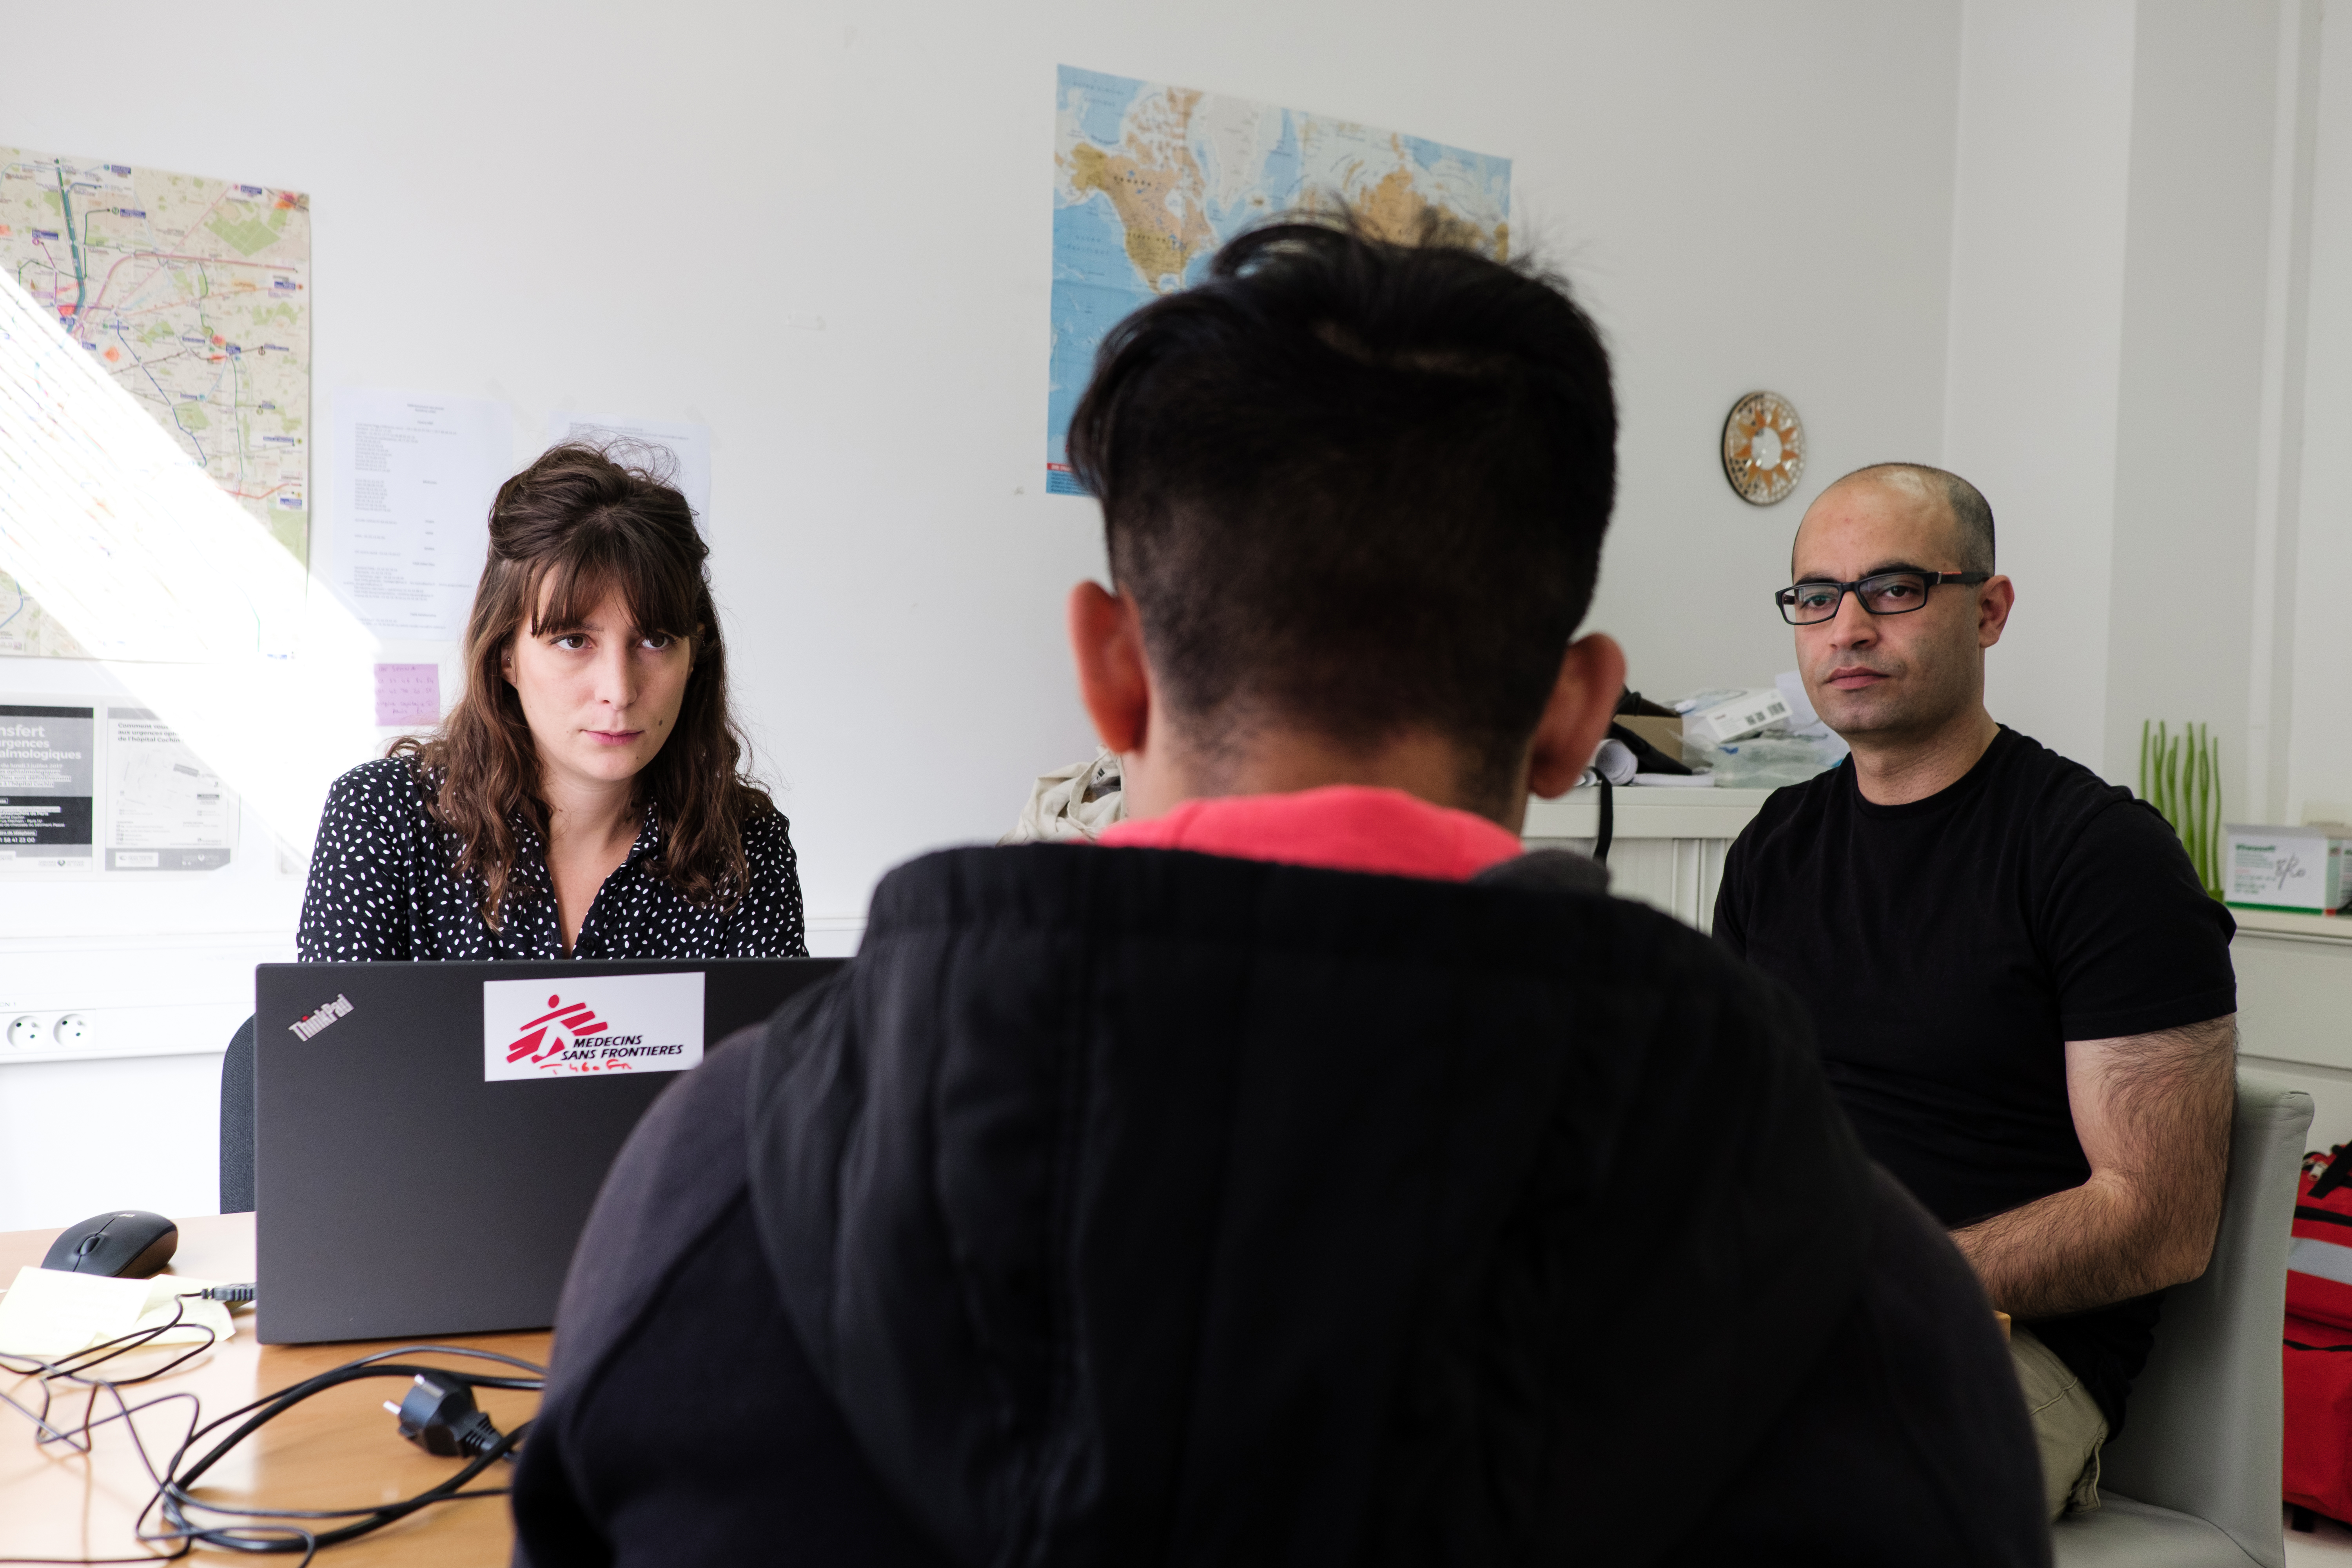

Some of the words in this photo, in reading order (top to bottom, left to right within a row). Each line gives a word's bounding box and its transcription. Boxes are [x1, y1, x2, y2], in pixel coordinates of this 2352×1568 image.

[288, 993, 354, 1042] ThinkPad
[573, 1035, 643, 1048] MEDECINS
[561, 1049, 596, 1060] SANS
[601, 1044, 684, 1059] FRONTIERES
